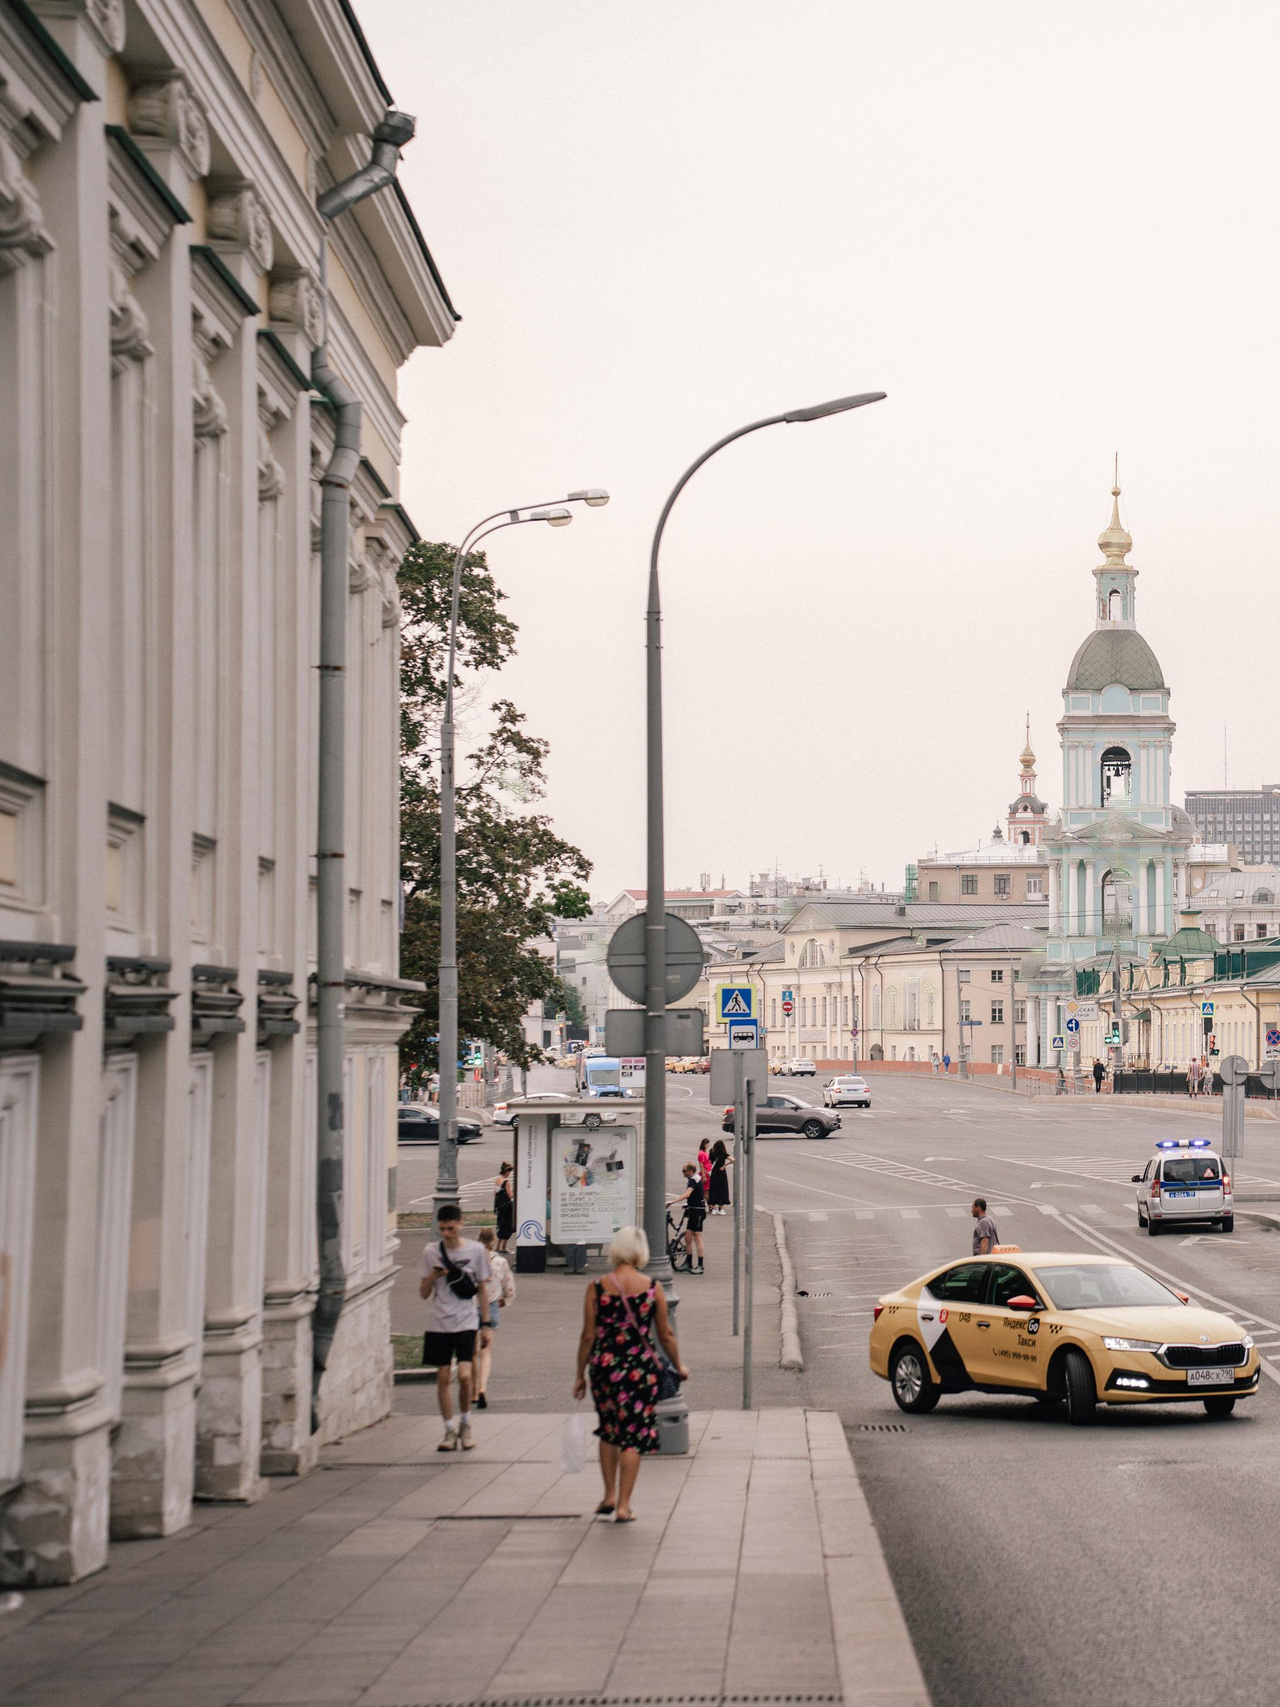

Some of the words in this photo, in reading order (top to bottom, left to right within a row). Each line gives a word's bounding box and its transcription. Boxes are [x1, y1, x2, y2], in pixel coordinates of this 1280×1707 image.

[941, 1311, 947, 1322] Я
[959, 1312, 971, 1323] 048
[1003, 1317, 1027, 1330] Яндекс
[1028, 1319, 1039, 1333] Go
[1017, 1334, 1036, 1347] Такси
[998, 1349, 1011, 1359] (495)
[1012, 1350, 1037, 1363] 999-99-99
